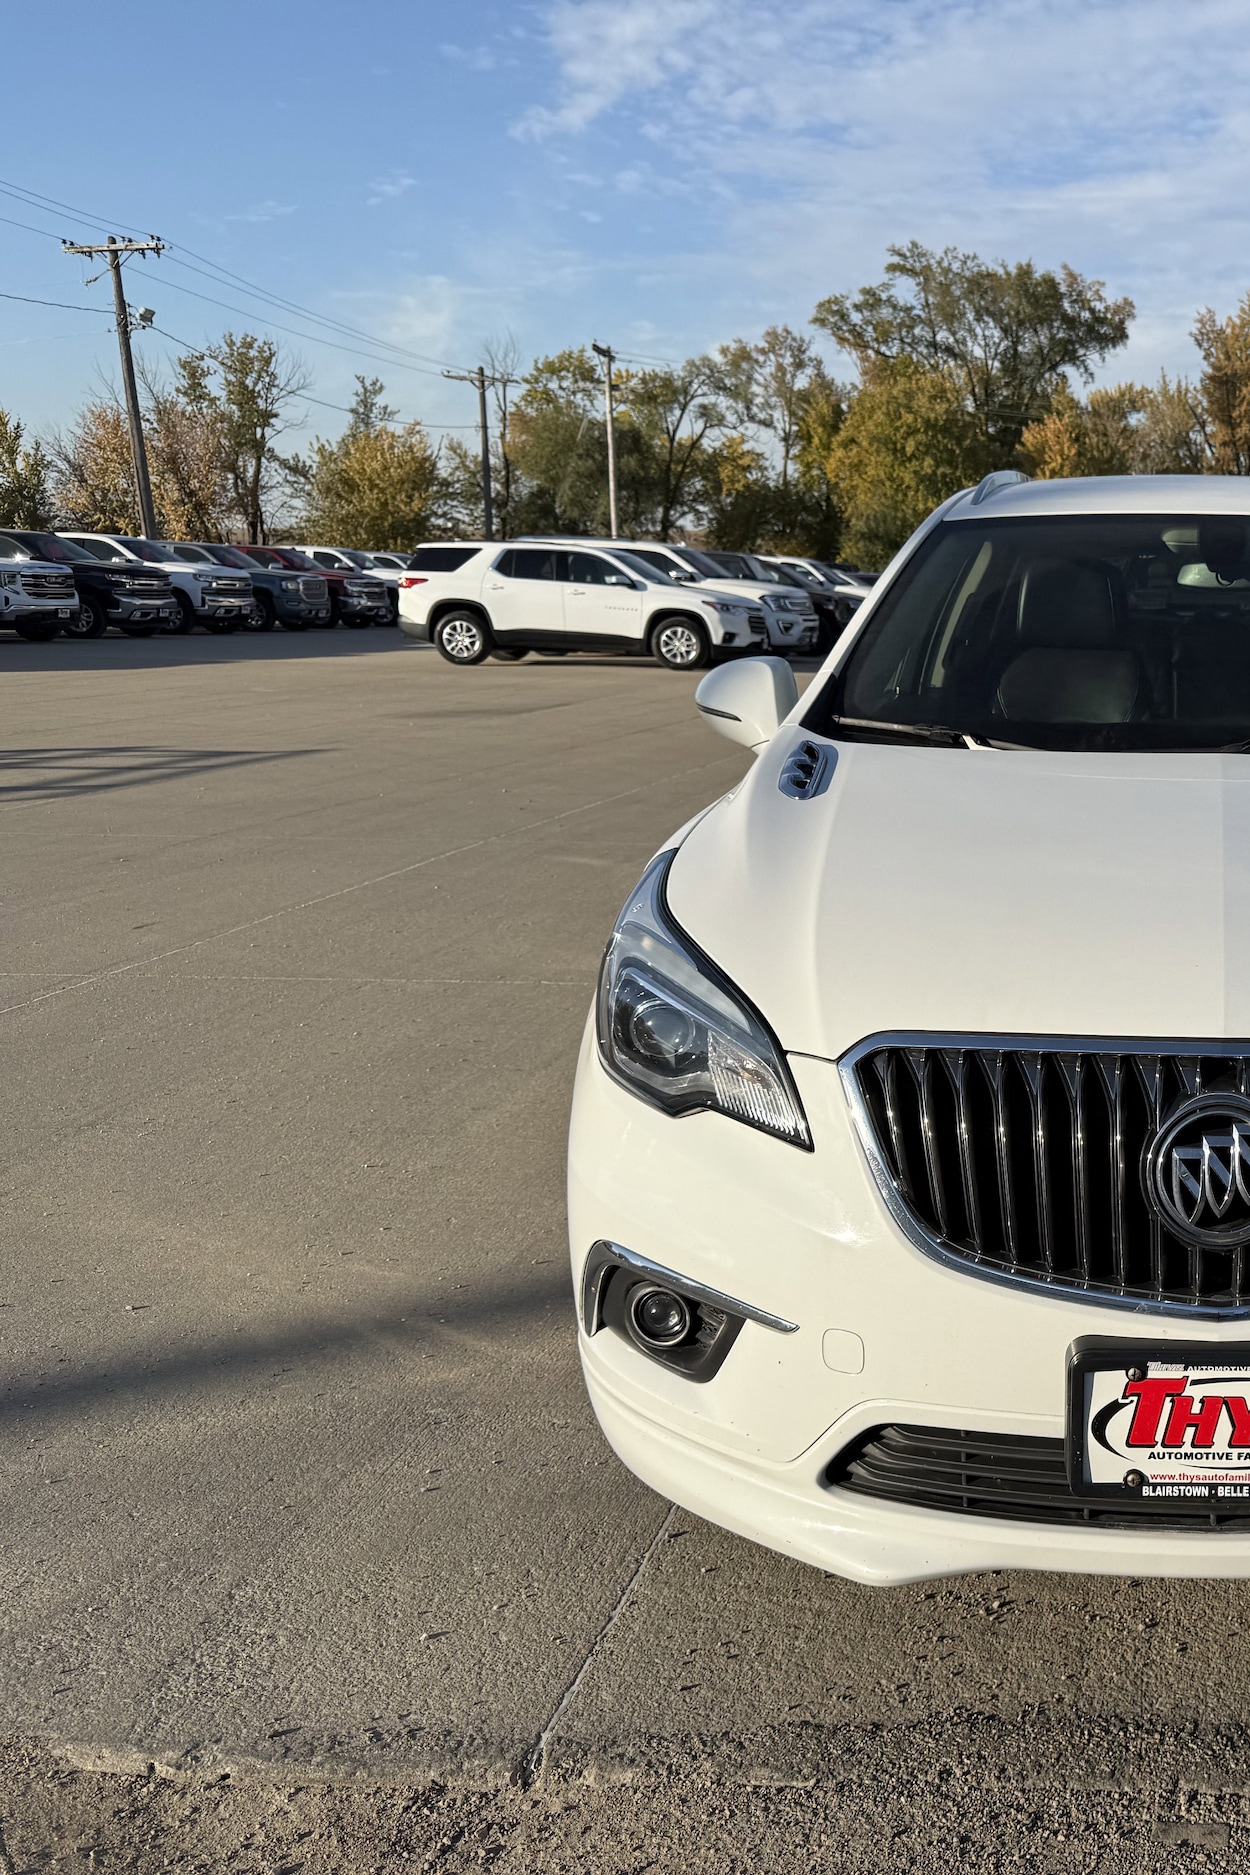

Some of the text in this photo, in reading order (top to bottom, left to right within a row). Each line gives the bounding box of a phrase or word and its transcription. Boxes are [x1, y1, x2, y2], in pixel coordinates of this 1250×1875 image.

[1147, 1451, 1234, 1461] AUTOMOTIVE
[1142, 1485, 1210, 1497] BLAIRSTOWN
[1217, 1486, 1250, 1497] BELLE
